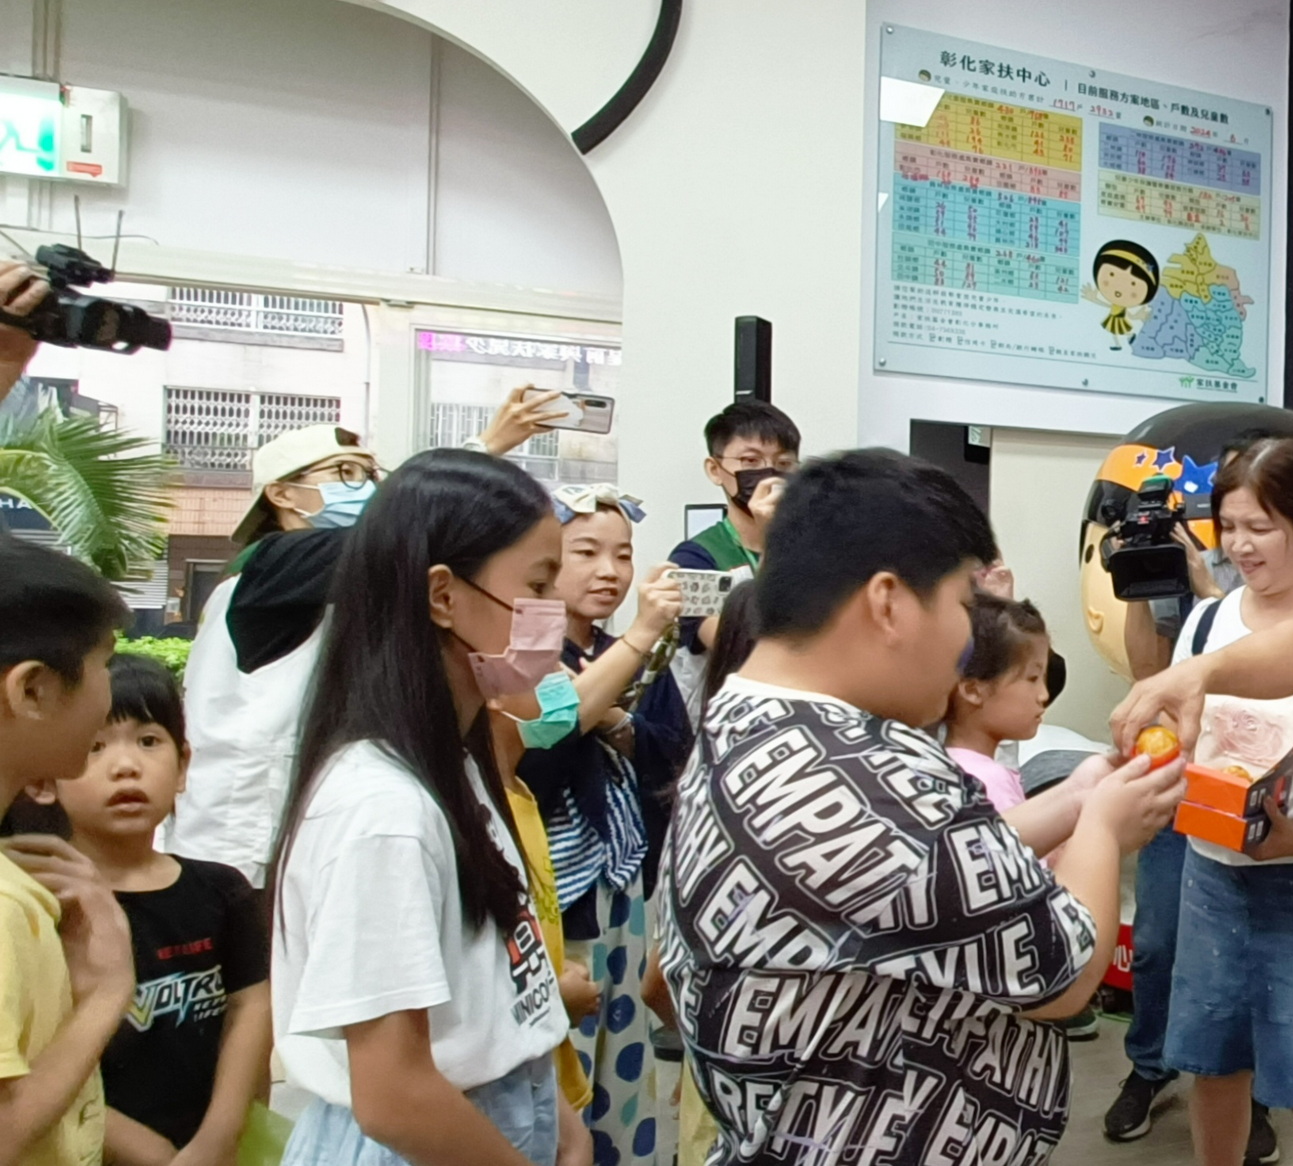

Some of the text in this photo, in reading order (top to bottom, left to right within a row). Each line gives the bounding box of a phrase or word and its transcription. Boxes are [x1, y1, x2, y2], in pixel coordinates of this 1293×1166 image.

[940, 50, 1051, 88] 彰化家扶中心
[1077, 83, 1229, 125] 目前服務方案地區、戶數及兒童數
